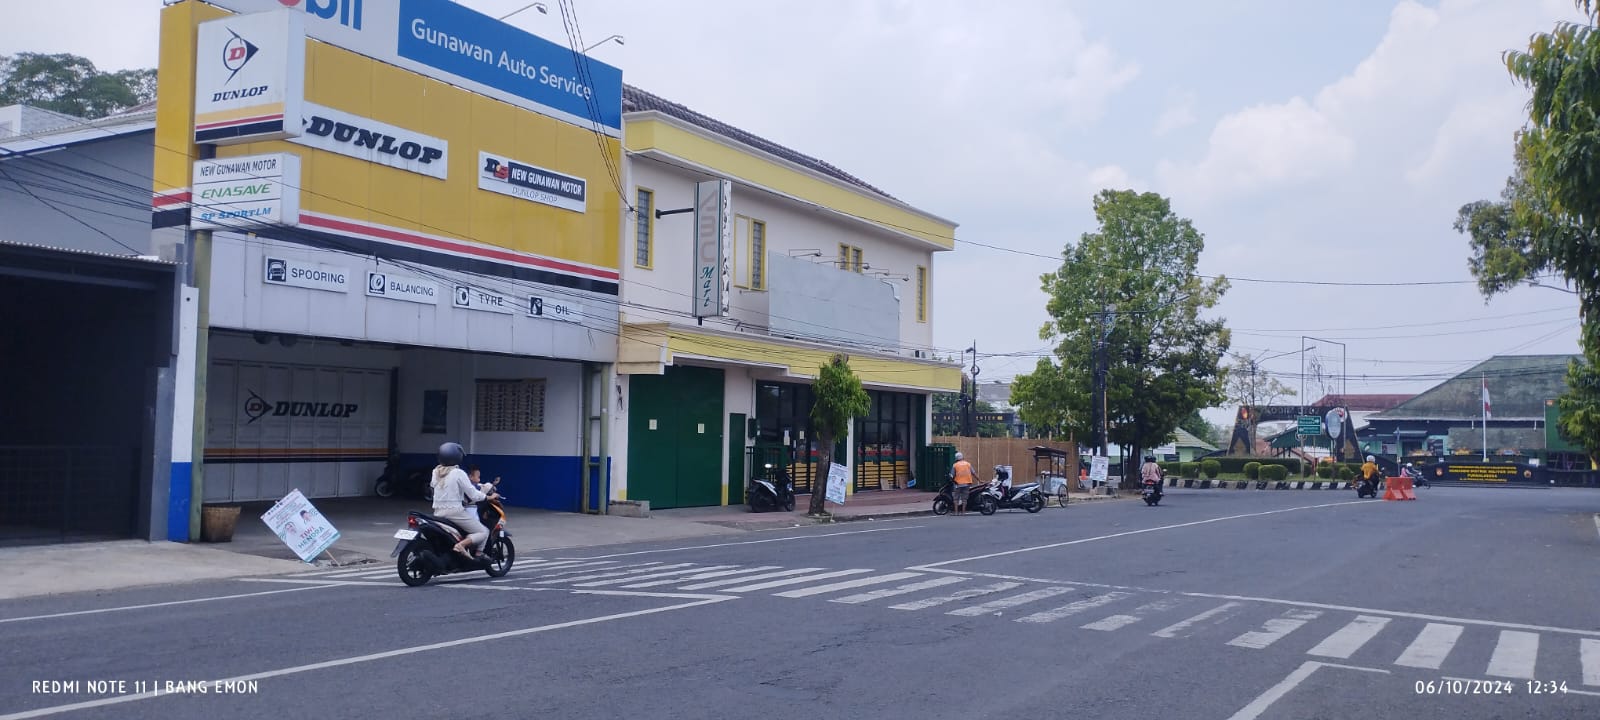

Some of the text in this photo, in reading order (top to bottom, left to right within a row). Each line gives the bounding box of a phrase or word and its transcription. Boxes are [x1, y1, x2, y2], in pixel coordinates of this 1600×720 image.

[412, 18, 592, 100] Gunawan Auto Service
[212, 85, 268, 102] DUNLOP
[306, 115, 443, 164] DUNLOP
[200, 159, 277, 176] NEW GUNAWAN MOTOR
[511, 168, 582, 196] NEW GUNAWAN MOTOR
[201, 183, 272, 199] ENASAVE
[512, 186, 558, 203] DUNLOP SHOP
[292, 268, 345, 284] SPOORING
[390, 282, 434, 296] BALANCING
[700, 265, 715, 307] Mart
[479, 294, 504, 306] TYRE
[556, 305, 569, 315] OIL
[272, 401, 358, 418] DUNLOP
